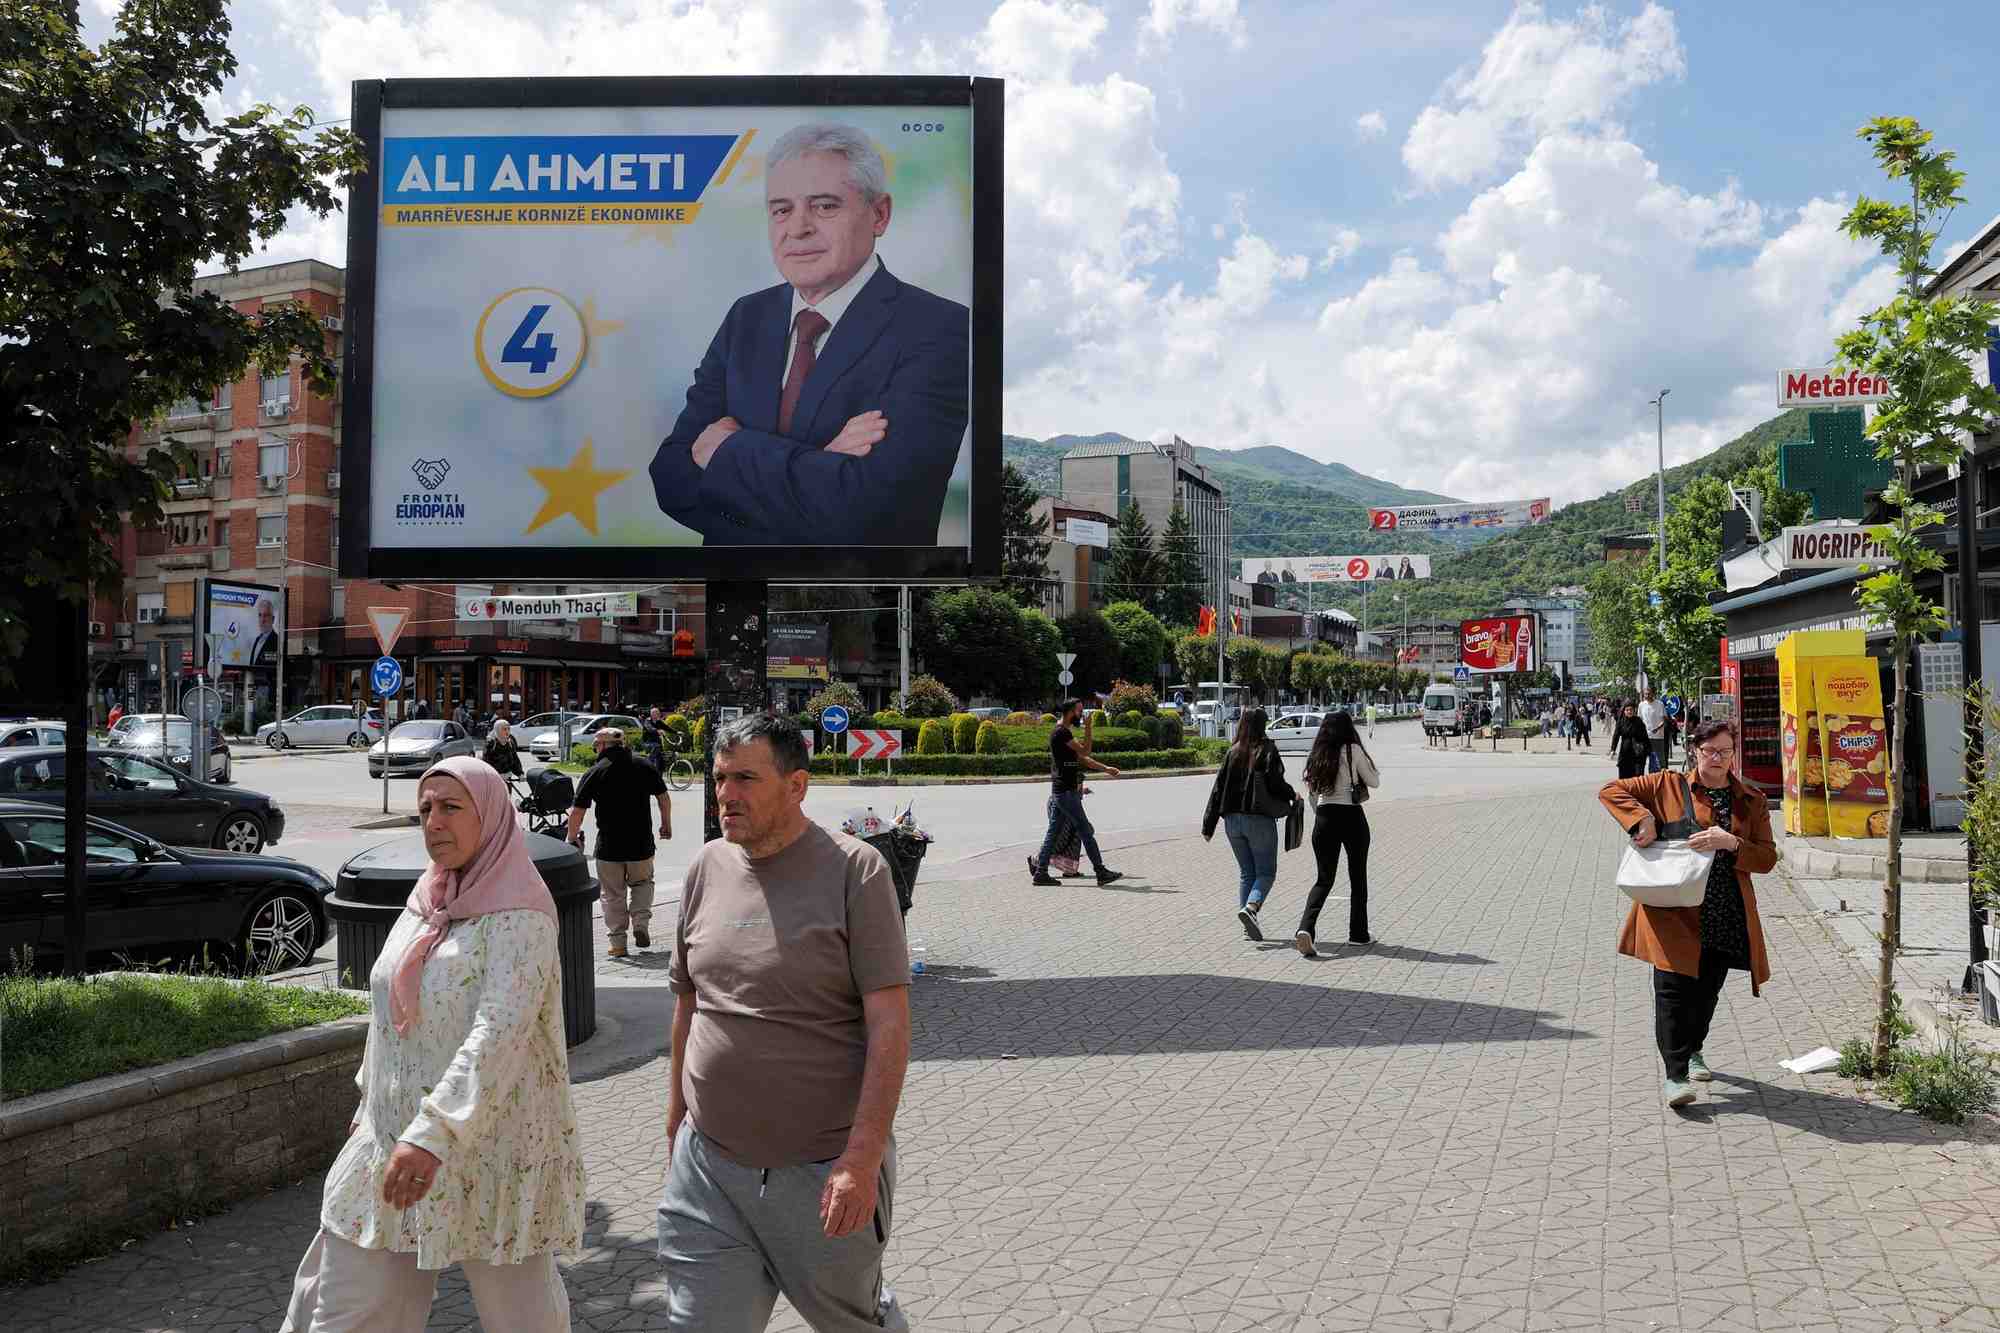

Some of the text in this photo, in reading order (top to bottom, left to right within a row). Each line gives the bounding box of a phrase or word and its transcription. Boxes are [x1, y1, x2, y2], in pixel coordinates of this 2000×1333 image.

[397, 153, 685, 192] ALI AHMETI
[397, 205, 685, 223] MARRËVESHJE KORNIZË EKONOMIKE
[501, 305, 557, 373] 4
[1786, 370, 1888, 399] Metafen
[403, 494, 459, 503] FRONTI
[396, 503, 465, 519] EUROPIAN
[1379, 512, 1392, 528] 2
[1352, 561, 1364, 577] 2
[501, 599, 561, 616] Menduh
[565, 597, 607, 617] Thaçi
[1465, 631, 1489, 645] bravo
